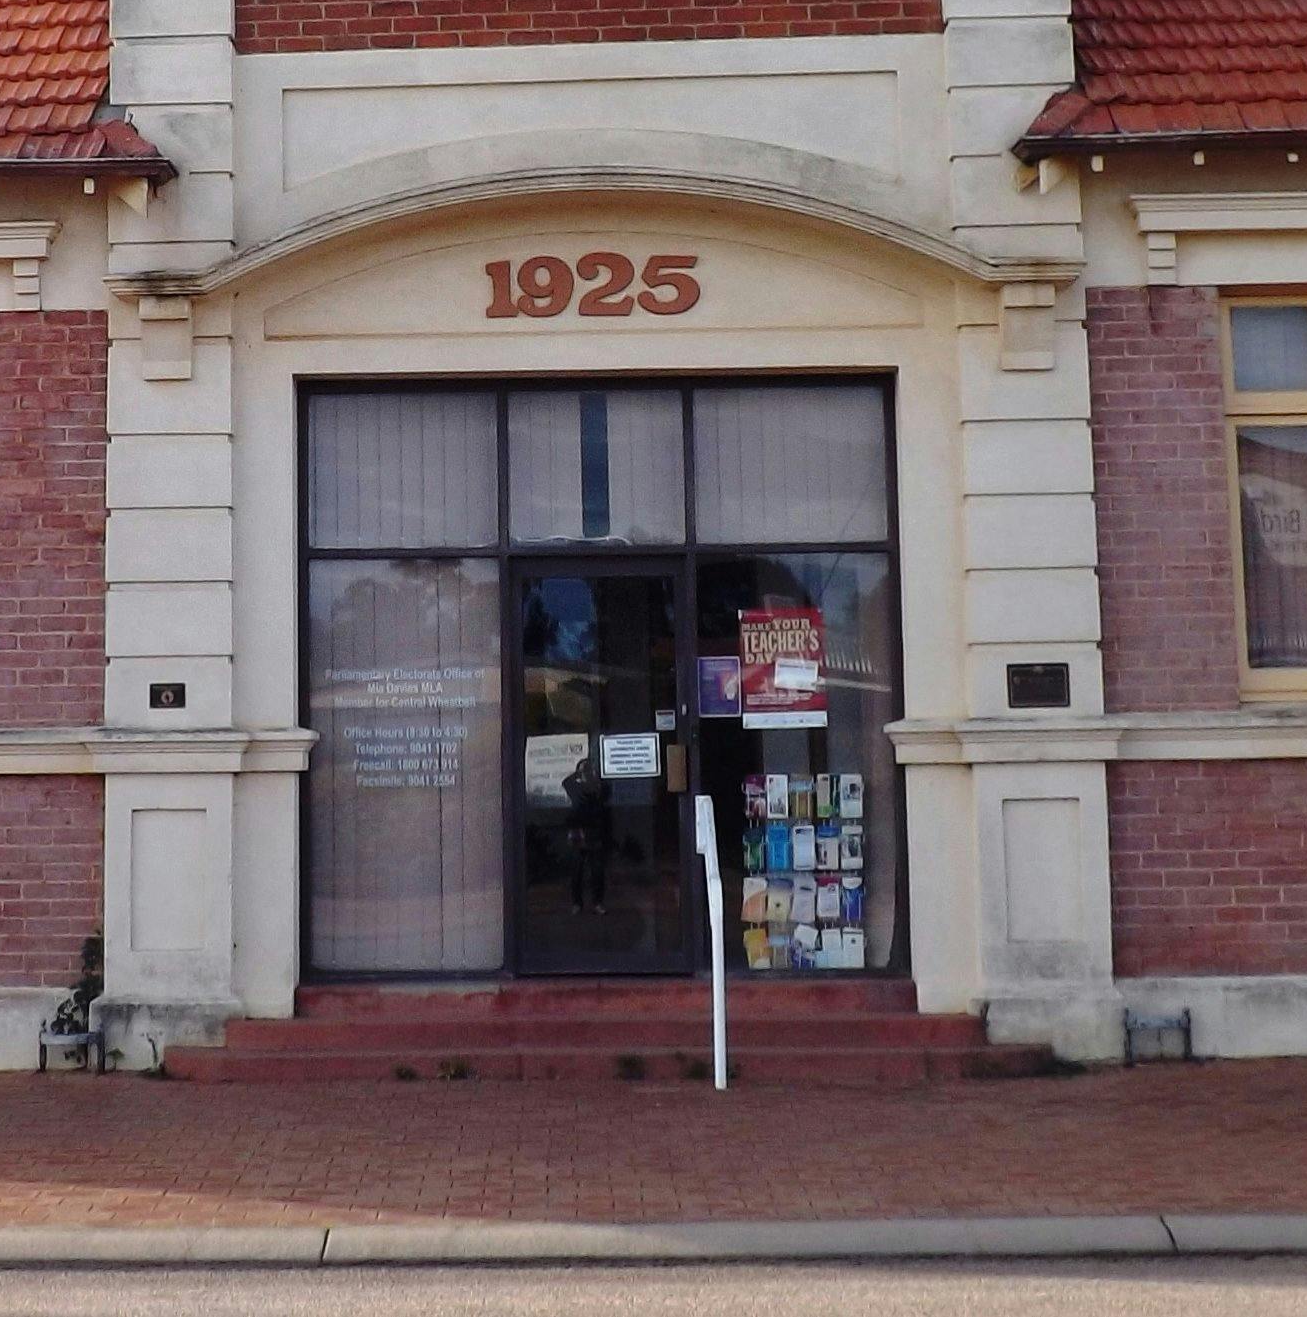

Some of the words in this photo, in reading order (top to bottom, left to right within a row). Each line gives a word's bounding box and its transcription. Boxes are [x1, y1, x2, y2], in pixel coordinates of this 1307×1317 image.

[485, 252, 701, 318] 1925
[772, 618, 811, 631] YOUR
[742, 629, 819, 653] TEACHER'S
[744, 652, 774, 664] DAY
[444, 668, 473, 679] Office
[367, 682, 384, 693] Mia
[386, 682, 419, 694] Davies
[422, 682, 443, 693] MLA
[334, 697, 372, 708] Member
[376, 697, 390, 708] for
[391, 697, 426, 708] Central
[344, 727, 372, 739] Office
[374, 727, 403, 738] Hours
[432, 727, 443, 738] to
[356, 743, 406, 756] Telephone:
[398, 760, 420, 771] 1800
